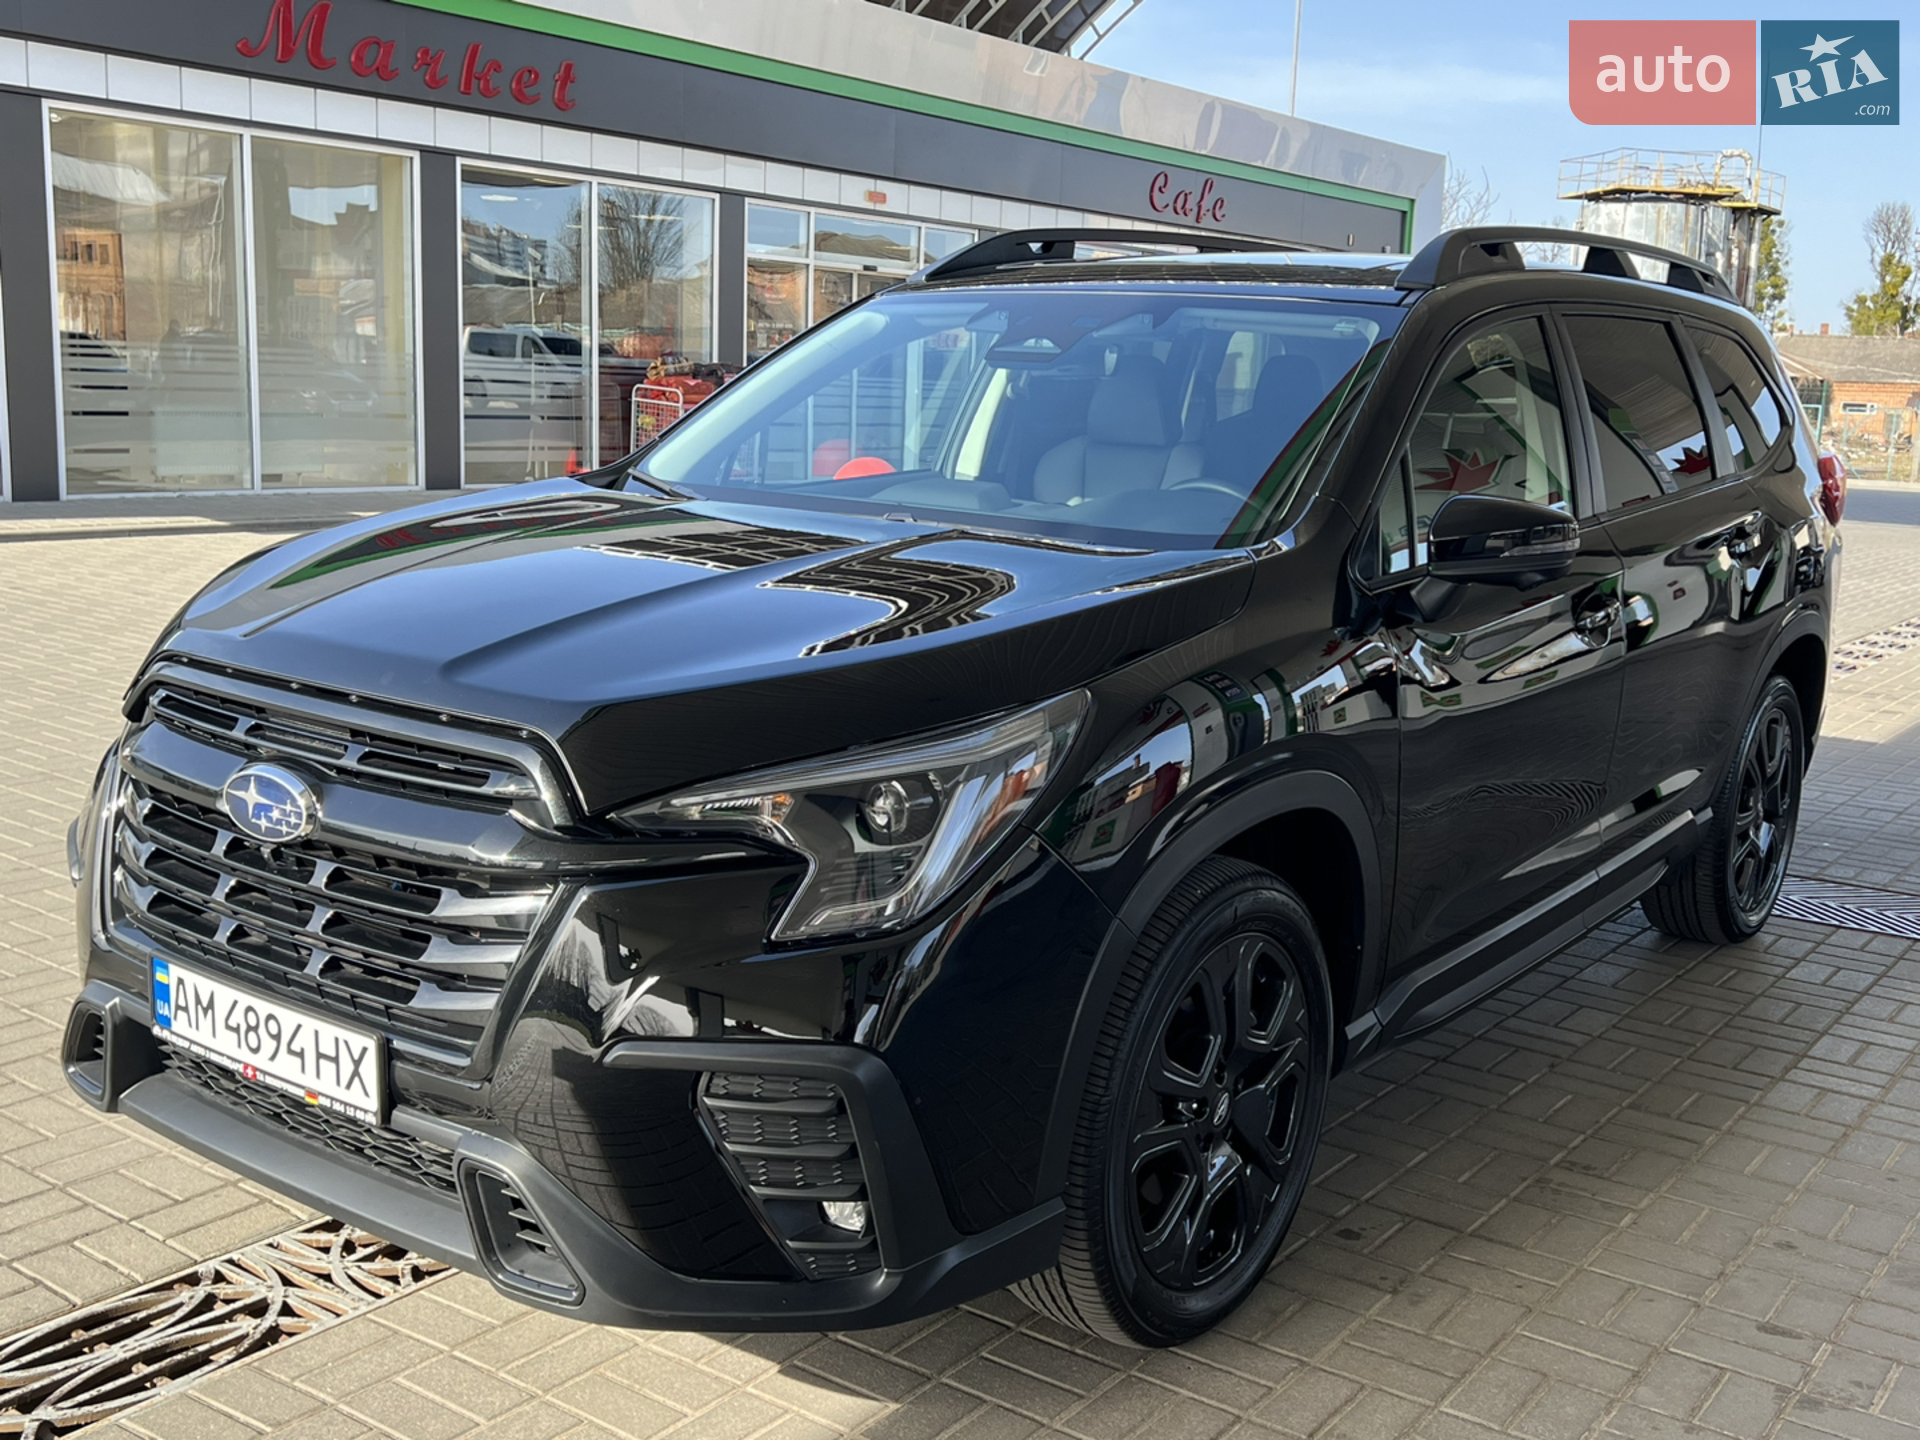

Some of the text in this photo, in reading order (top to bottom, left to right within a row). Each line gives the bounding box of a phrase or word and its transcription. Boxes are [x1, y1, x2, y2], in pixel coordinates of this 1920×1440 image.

[236, 0, 578, 112] Market
[1149, 171, 1226, 224] Cafe
[156, 998, 170, 1018] UA
